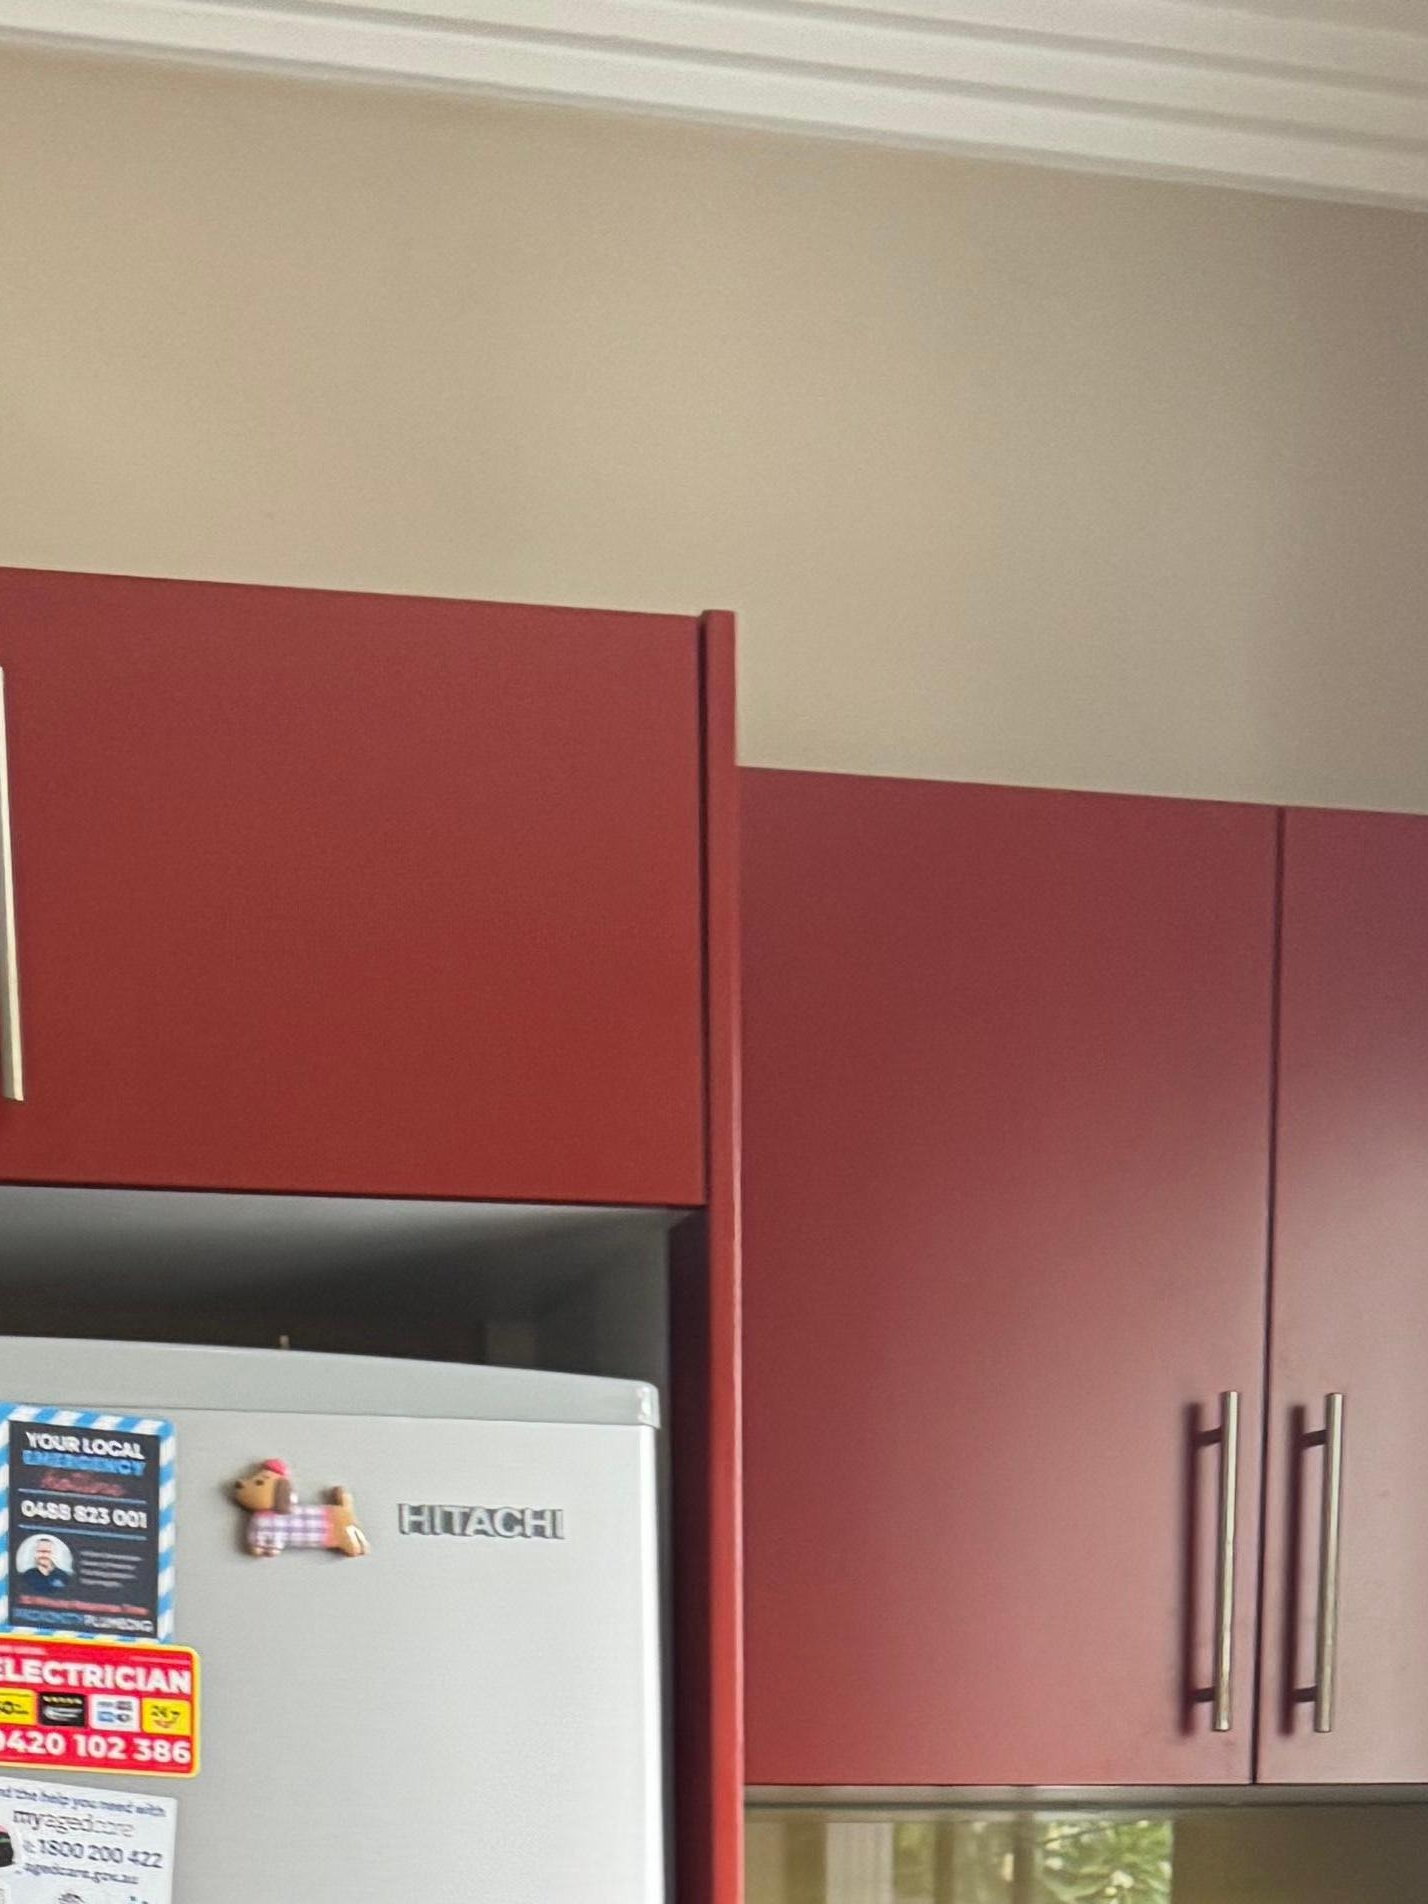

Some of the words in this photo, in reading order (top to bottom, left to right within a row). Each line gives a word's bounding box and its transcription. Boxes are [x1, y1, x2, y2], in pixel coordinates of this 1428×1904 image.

[26, 1431, 80, 1453] YOUR
[82, 1438, 145, 1460] LOCAL
[397, 1503, 564, 1540] HITACHI
[72, 1734, 127, 1760] 102
[132, 1738, 192, 1764] 386
[14, 1788, 39, 1801] the
[13, 1809, 135, 1837] myagedcare
[38, 1838, 83, 1859] 1800
[87, 1844, 124, 1864] 200
[127, 1849, 164, 1869] 422
